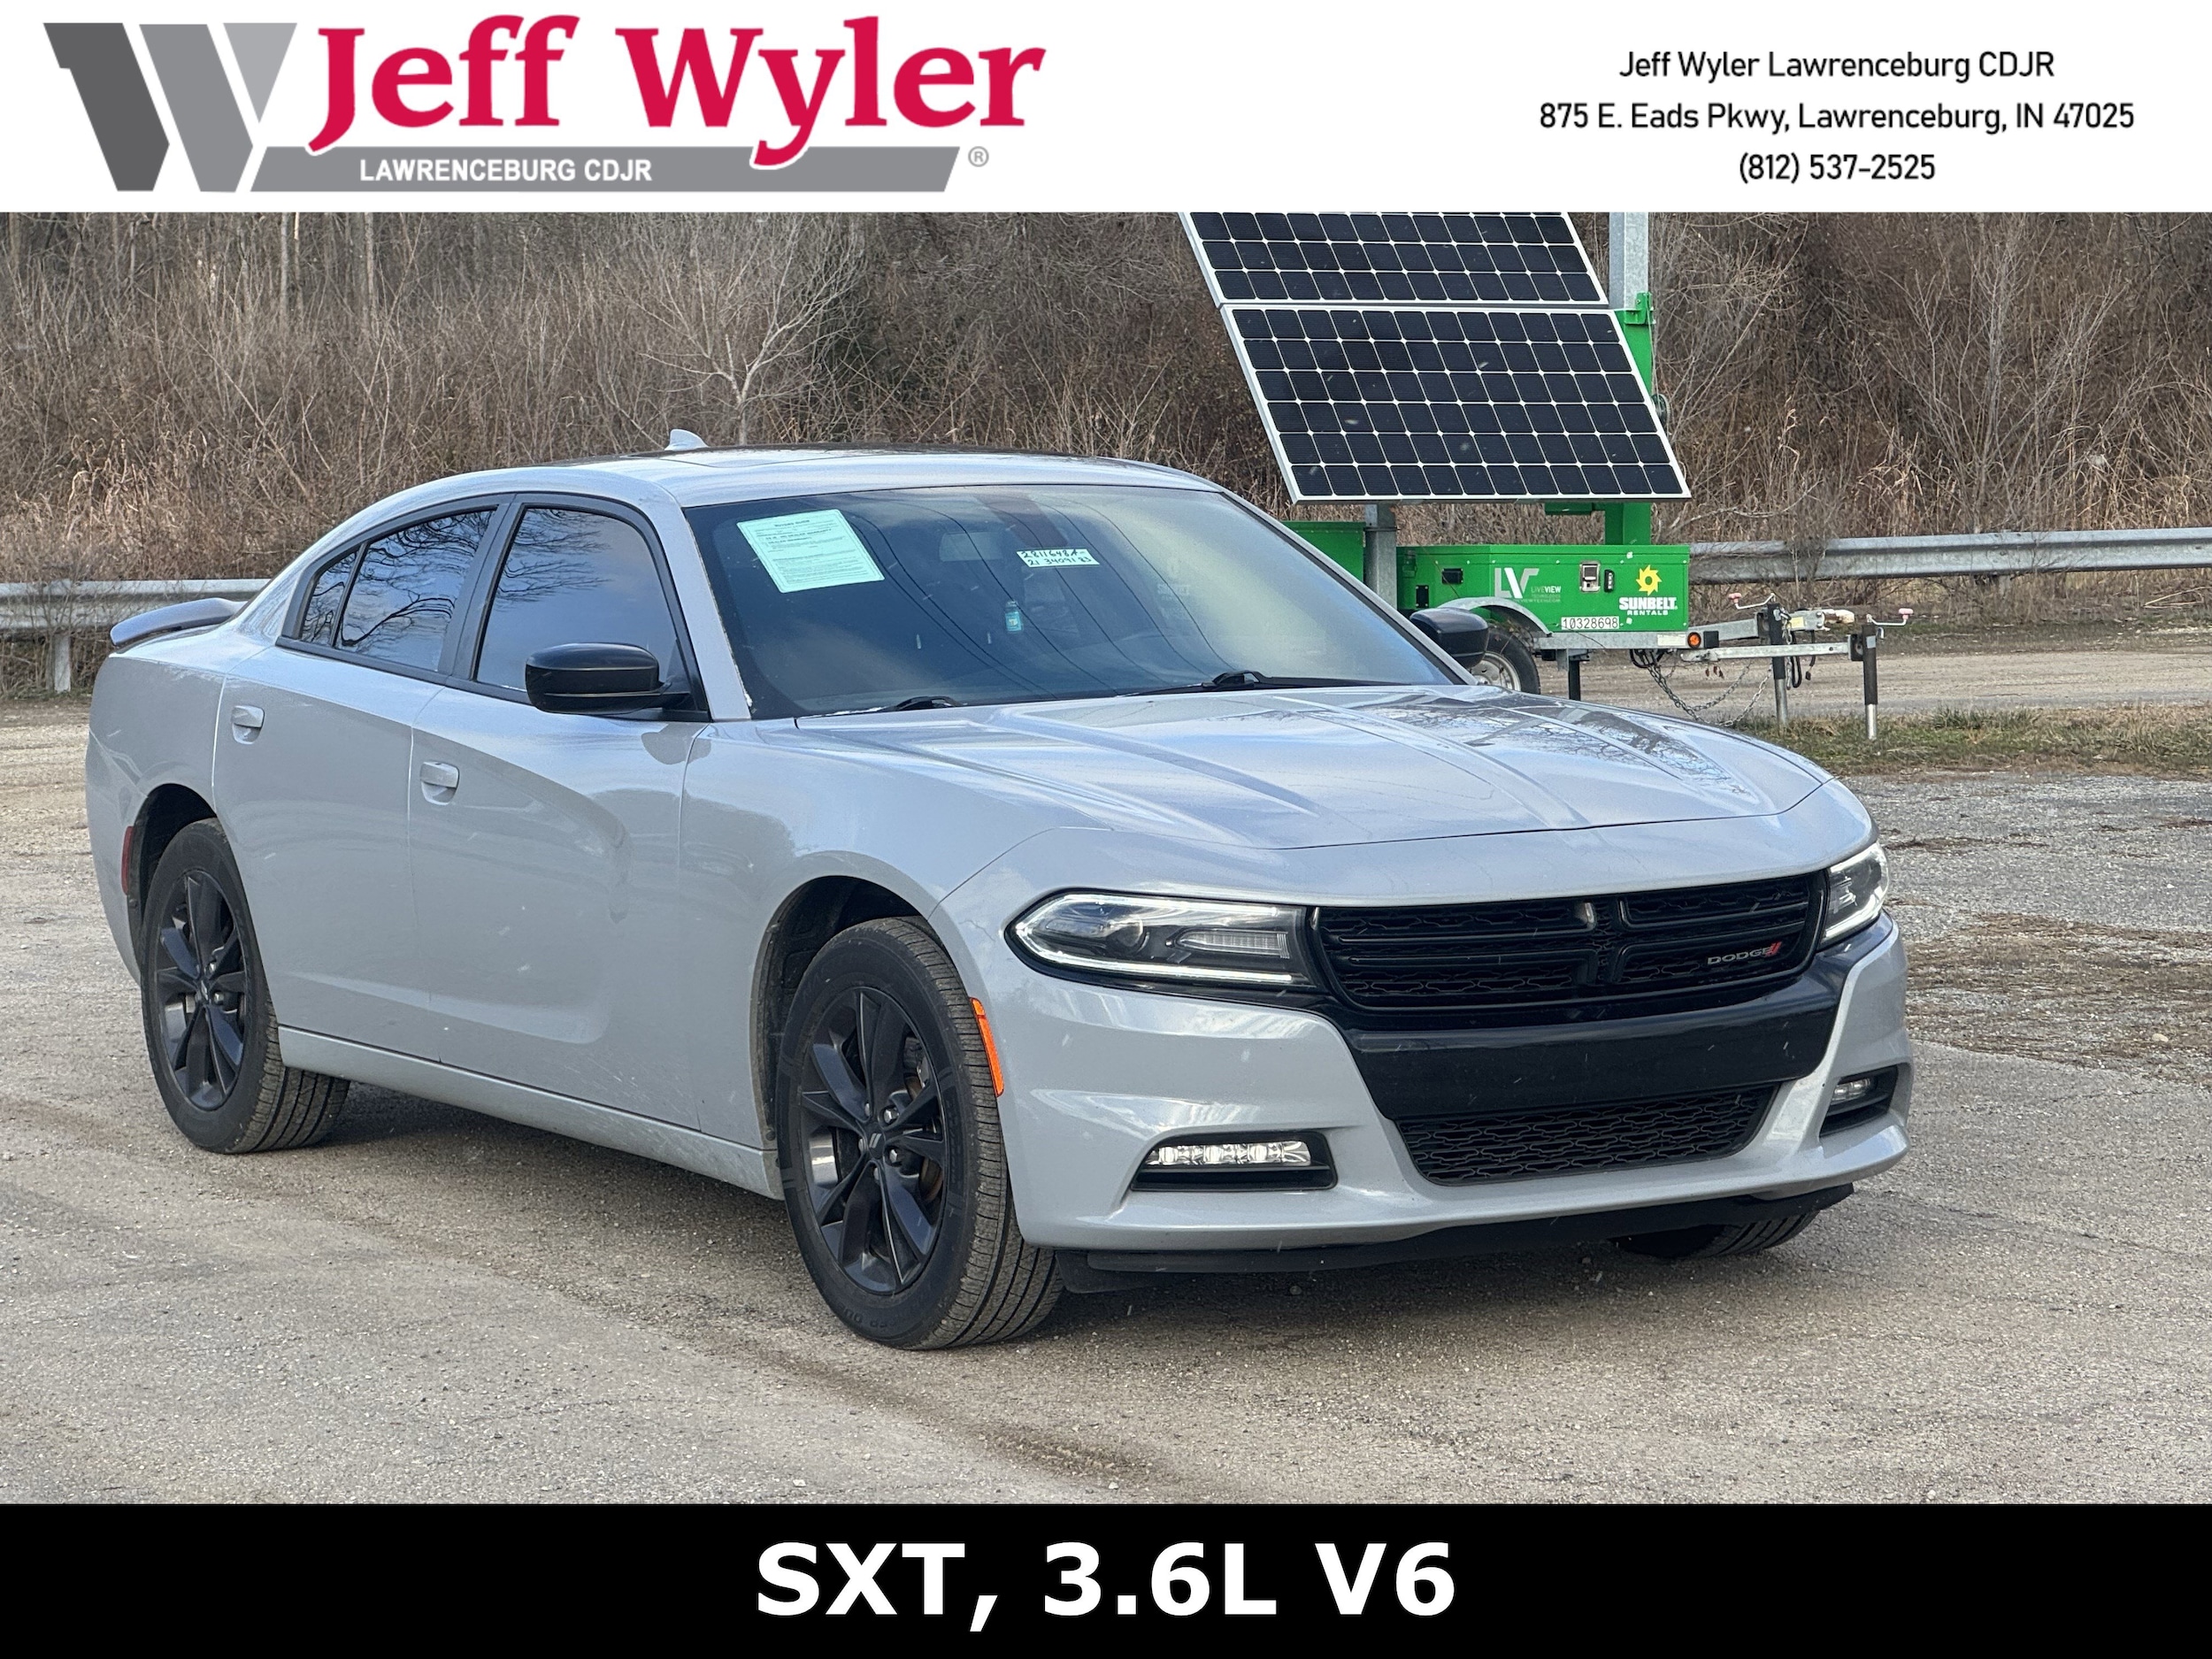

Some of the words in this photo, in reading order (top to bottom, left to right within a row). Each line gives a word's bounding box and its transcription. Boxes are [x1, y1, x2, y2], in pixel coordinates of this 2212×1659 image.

[1618, 596, 1678, 611] SUNBELT
[1563, 617, 1618, 629] 10328698
[1707, 946, 1772, 965] DODGE
